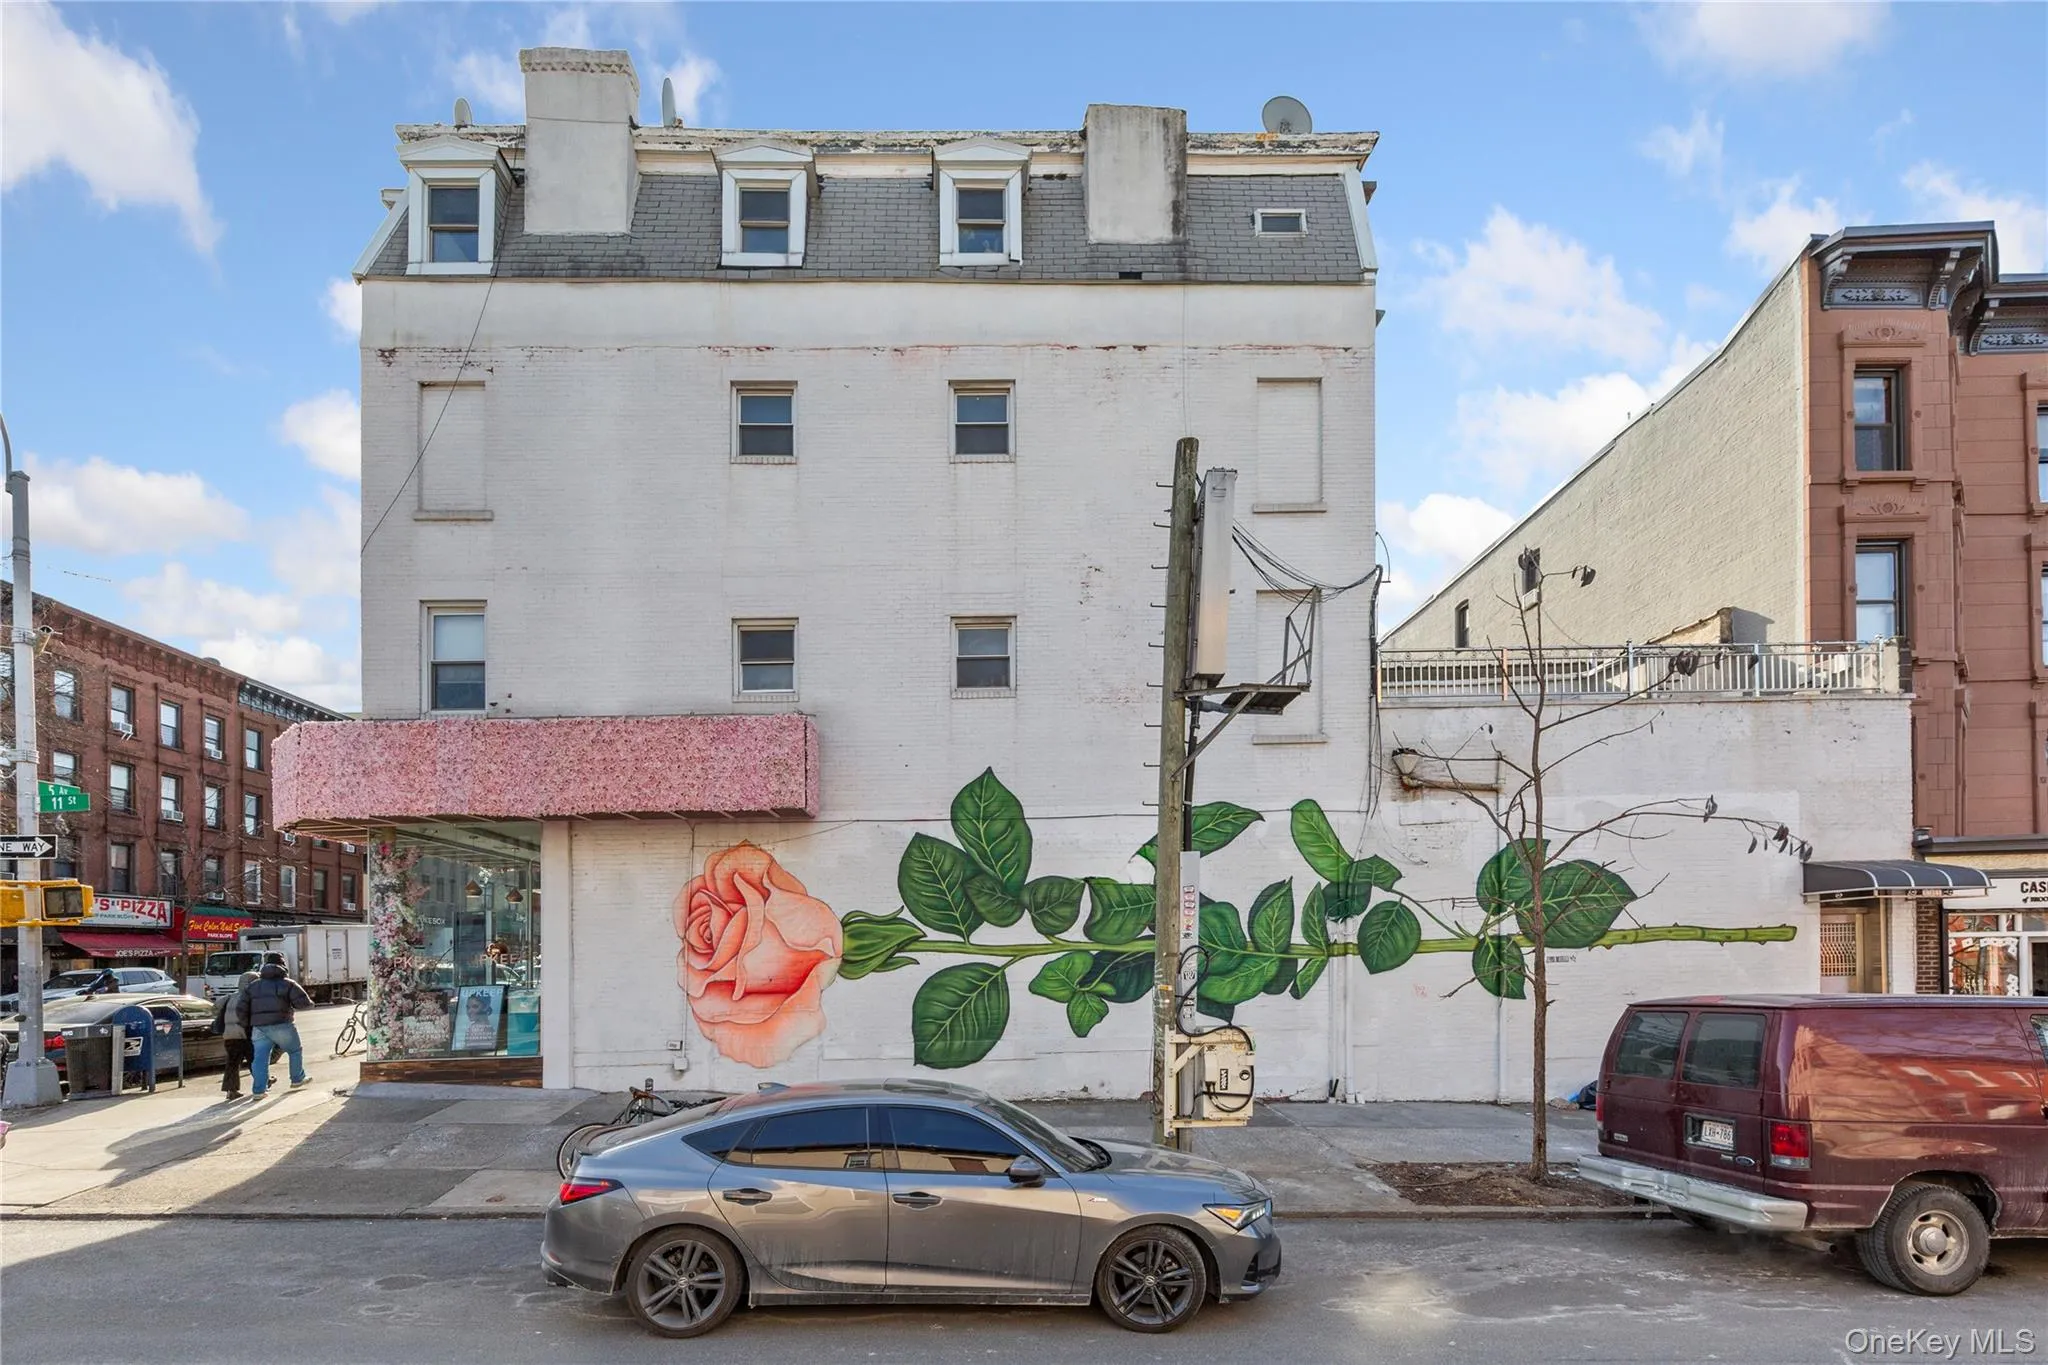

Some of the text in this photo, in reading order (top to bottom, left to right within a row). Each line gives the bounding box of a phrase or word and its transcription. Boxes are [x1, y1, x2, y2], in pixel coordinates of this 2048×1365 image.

[48, 785, 69, 796] 5 Av
[52, 796, 77, 810] 11 St
[0, 843, 45, 852] NE WAY
[2021, 881, 2048, 894] CAS
